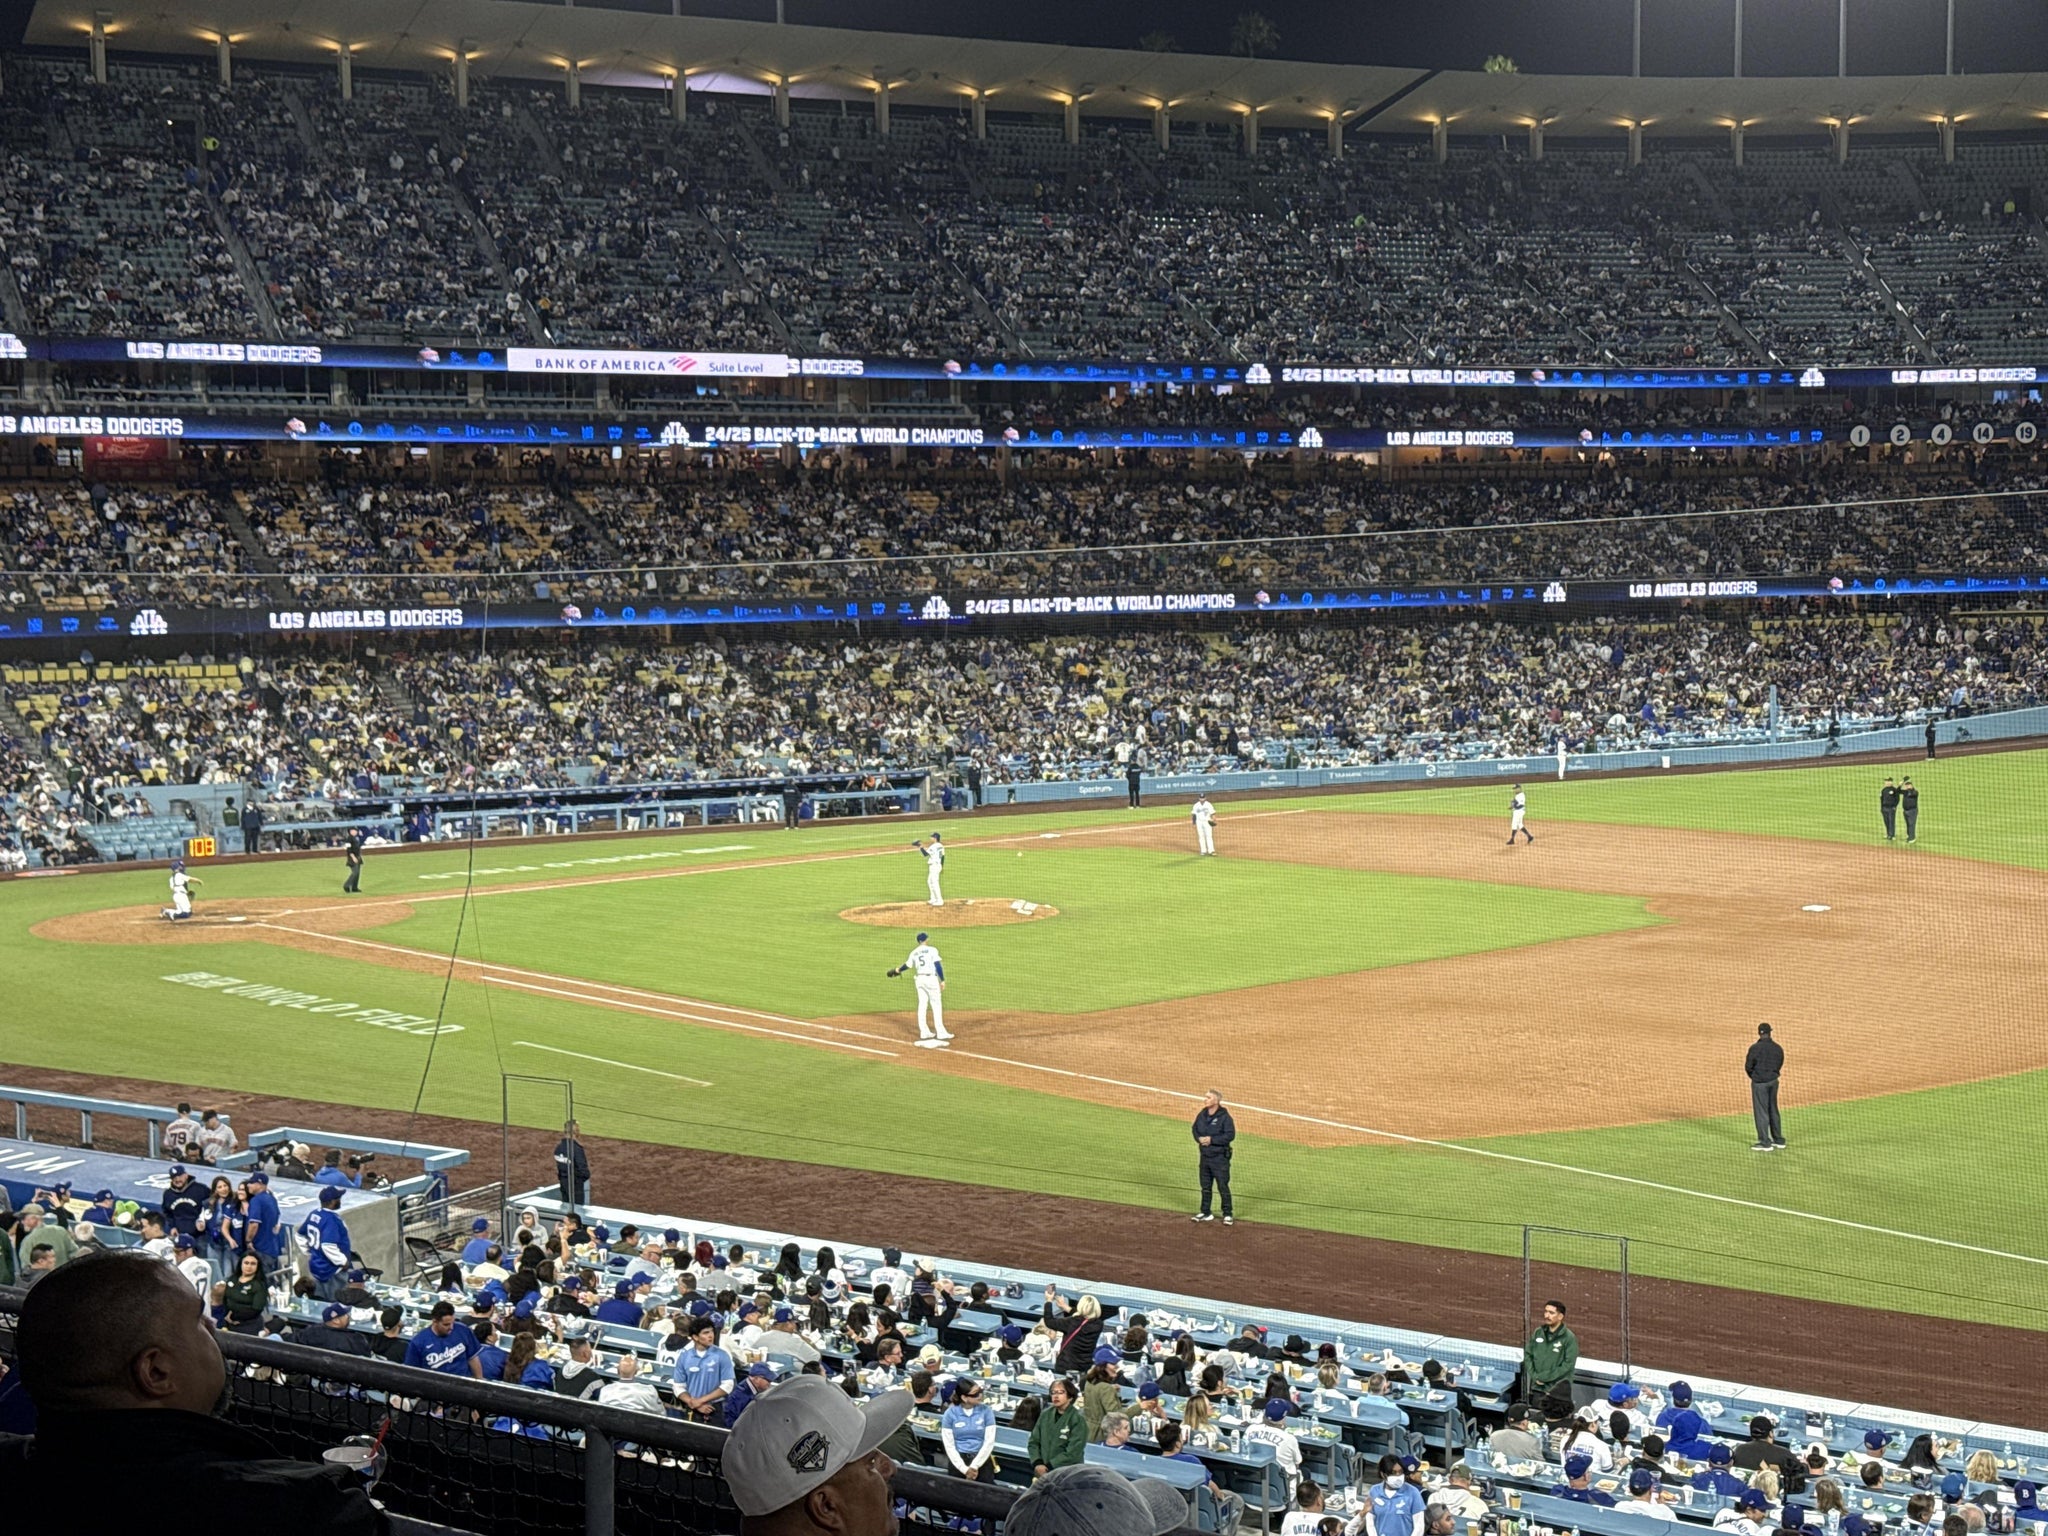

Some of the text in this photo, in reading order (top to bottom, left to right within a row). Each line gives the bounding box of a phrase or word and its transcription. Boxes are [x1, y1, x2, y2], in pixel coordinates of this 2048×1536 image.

[127, 342, 322, 363] LOS ANGELES DODGERS
[535, 358, 666, 371] BANK OF AMERICA
[709, 362, 763, 373] Suite Level
[1411, 369, 1453, 383] WORLD
[1454, 370, 1515, 384] CHAMPIONS
[1892, 367, 2036, 383] LOS ANGELES DODGERS
[21, 416, 103, 434] ANGELES
[107, 417, 183, 435] DODGERS
[2020, 426, 2033, 439] 19
[705, 426, 751, 442] 24/25
[754, 427, 858, 443] BACK-TO-BACK
[860, 428, 909, 443] WORLD
[912, 428, 984, 444] CHAMPIONS
[1387, 431, 1514, 445] LOS ANGELES DODGERS
[1896, 429, 1904, 442] 2
[1936, 428, 1945, 441] 4
[1977, 427, 1990, 440] 14
[1630, 581, 1757, 598] LOS ANGELES DODGERS
[965, 599, 1010, 614] 24/25
[1012, 596, 1113, 613] BACK-TO-BACK
[1116, 595, 1163, 611] WORLD
[1166, 594, 1236, 610] CHAMPIONS
[269, 609, 464, 629] LOS ANGELES DODGERS
[1079, 785, 1111, 794] Spectrum
[919, 955, 926, 967] 5
[222, 984, 465, 1035] UNIQLO FIELD
[170, 1132, 187, 1146] 79
[426, 1343, 466, 1366] Dodgers
[1248, 1430, 1284, 1446] GONZALEZ
[2021, 1488, 2030, 1499] B
